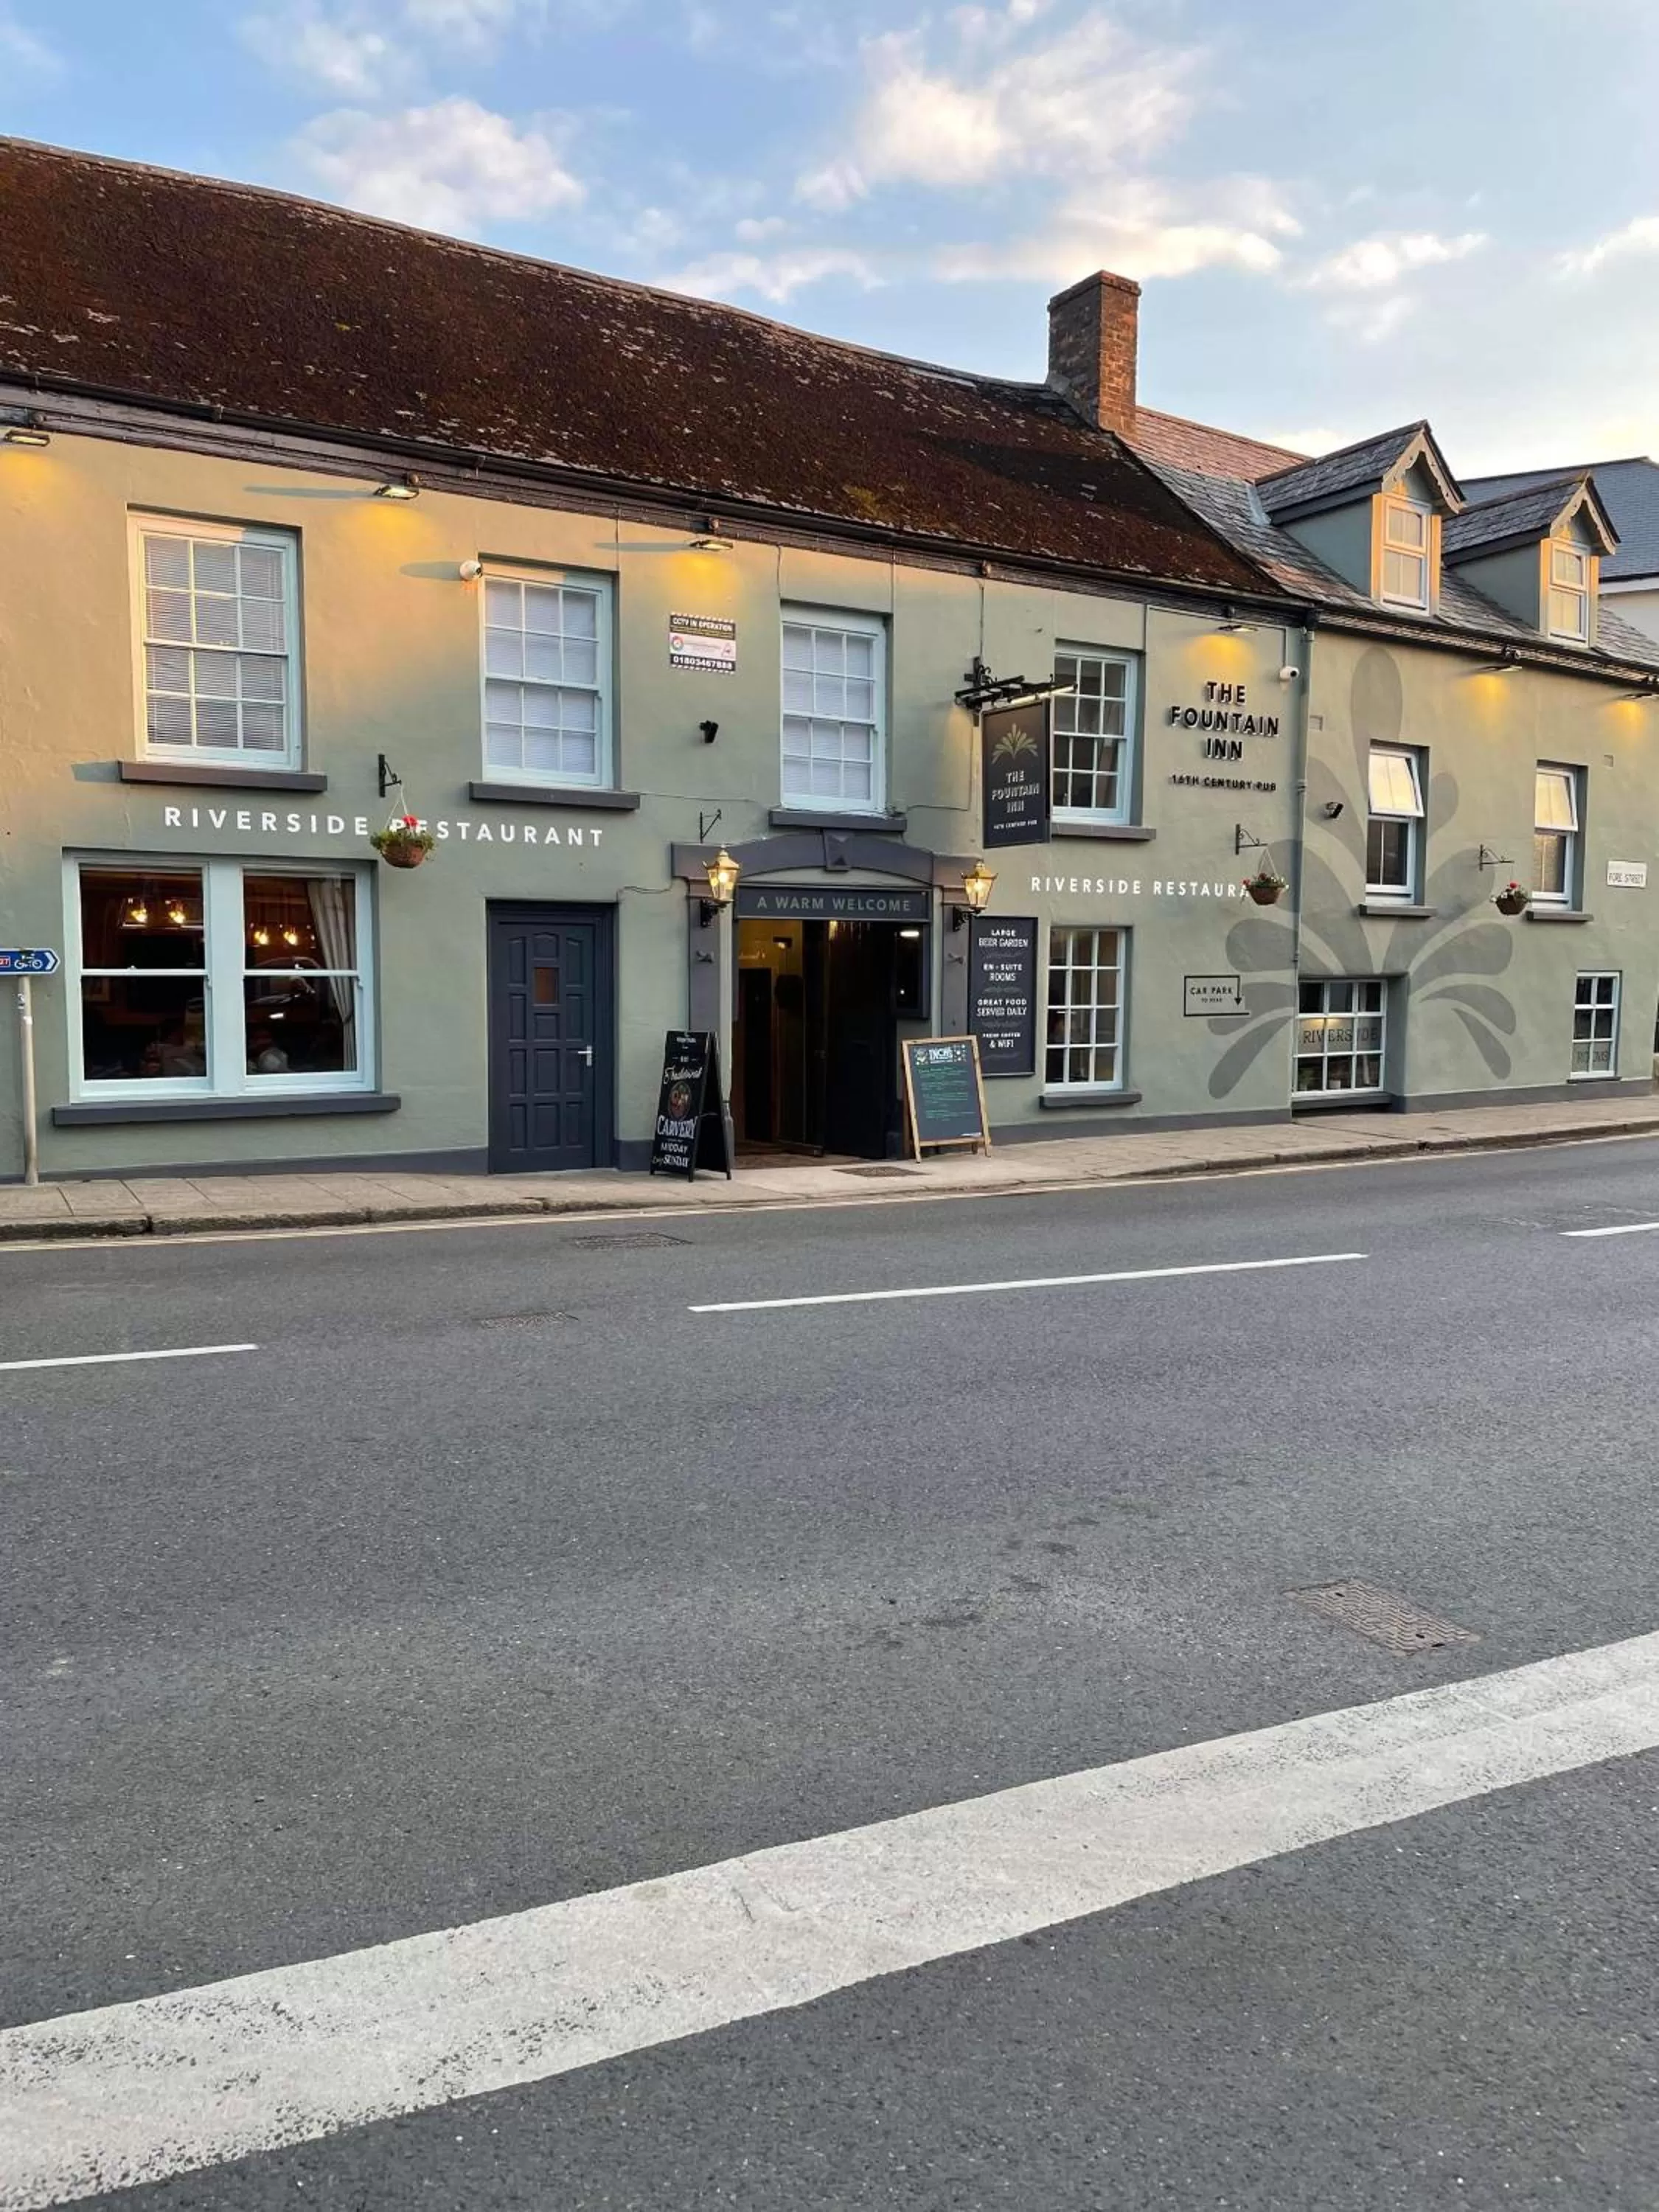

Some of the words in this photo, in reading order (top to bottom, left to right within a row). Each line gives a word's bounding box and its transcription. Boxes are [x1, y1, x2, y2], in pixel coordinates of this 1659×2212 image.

[672, 617, 689, 626] CCTV
[690, 619, 698, 627] IN
[698, 621, 732, 631] OPERATION
[1206, 681, 1246, 704] THE
[1169, 706, 1279, 736] FOUNTAIN
[1206, 738, 1244, 760] INN
[1006, 770, 1024, 783] THE
[1171, 775, 1200, 786] 16TH
[1204, 777, 1252, 790] CENTURY
[1256, 782, 1277, 792] PUB
[992, 783, 1040, 801] FOUNTAIN
[1006, 800, 1024, 813] INN
[165, 807, 368, 835] RIVERSIDE
[1032, 877, 1141, 894] RIVERSIDE
[1153, 880, 1251, 897] RESTAURA
[757, 896, 768, 909] A
[776, 896, 824, 910] WARM
[832, 897, 911, 911] WELCOME
[978, 938, 998, 947] BEER
[999, 938, 1029, 947] GARDEN
[990, 973, 1017, 981] ROOMS
[976, 1007, 1005, 1016] SERVED
[1006, 1006, 1027, 1015] DAILY
[990, 1040, 996, 1048] &
[658, 1114, 698, 1139] CARVERY
[661, 1142, 688, 1154] MIDDAY
[664, 1154, 689, 1168] SUNDAY
